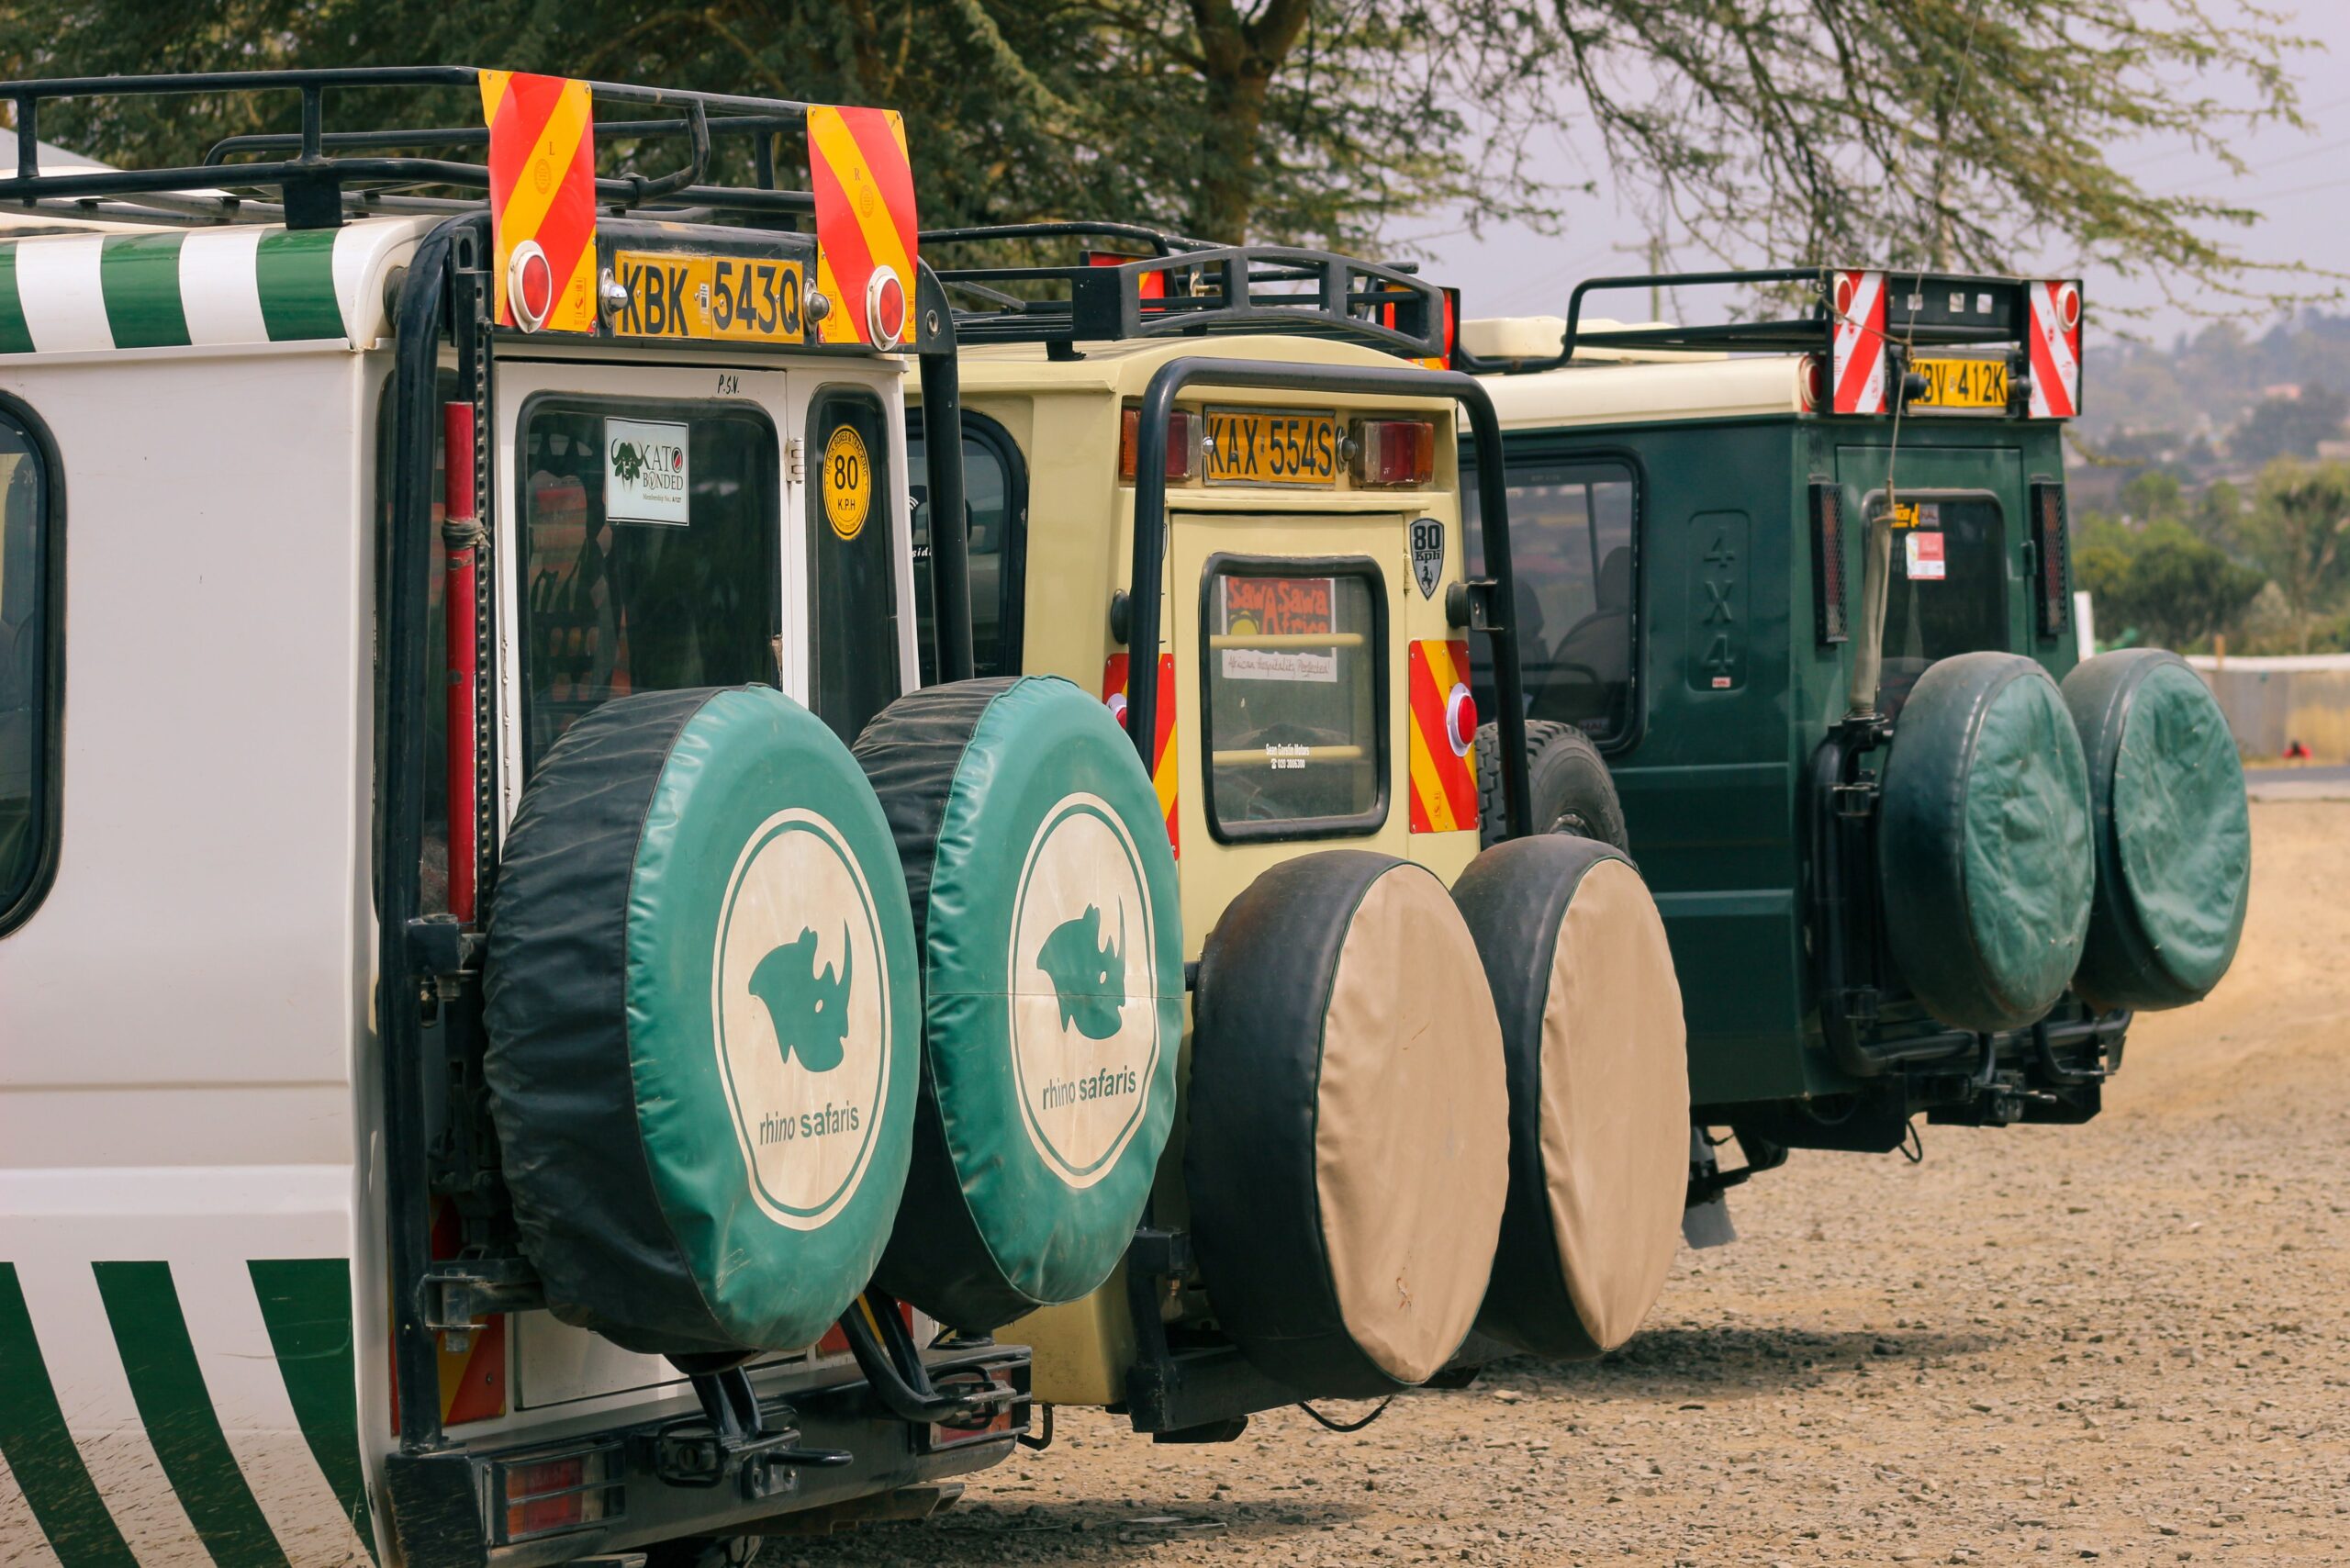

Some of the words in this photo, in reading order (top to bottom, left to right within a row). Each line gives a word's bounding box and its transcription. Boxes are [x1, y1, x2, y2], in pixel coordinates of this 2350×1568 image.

[854, 167, 861, 181] R
[622, 262, 688, 336] KBK
[712, 261, 800, 335] 543Q
[1957, 363, 2008, 403] 412K
[643, 444, 684, 474] KATO
[1209, 418, 1259, 475] KAX
[1270, 420, 1333, 477] 554S
[643, 471, 684, 491] BONDED
[834, 454, 858, 490] 80
[837, 498, 856, 510] K.P.H
[1414, 524, 1440, 550] 80
[1043, 1077, 1076, 1110] rhino
[1080, 1065, 1136, 1102] safaris
[759, 1111, 796, 1145] rhino
[800, 1100, 859, 1137] safaris
